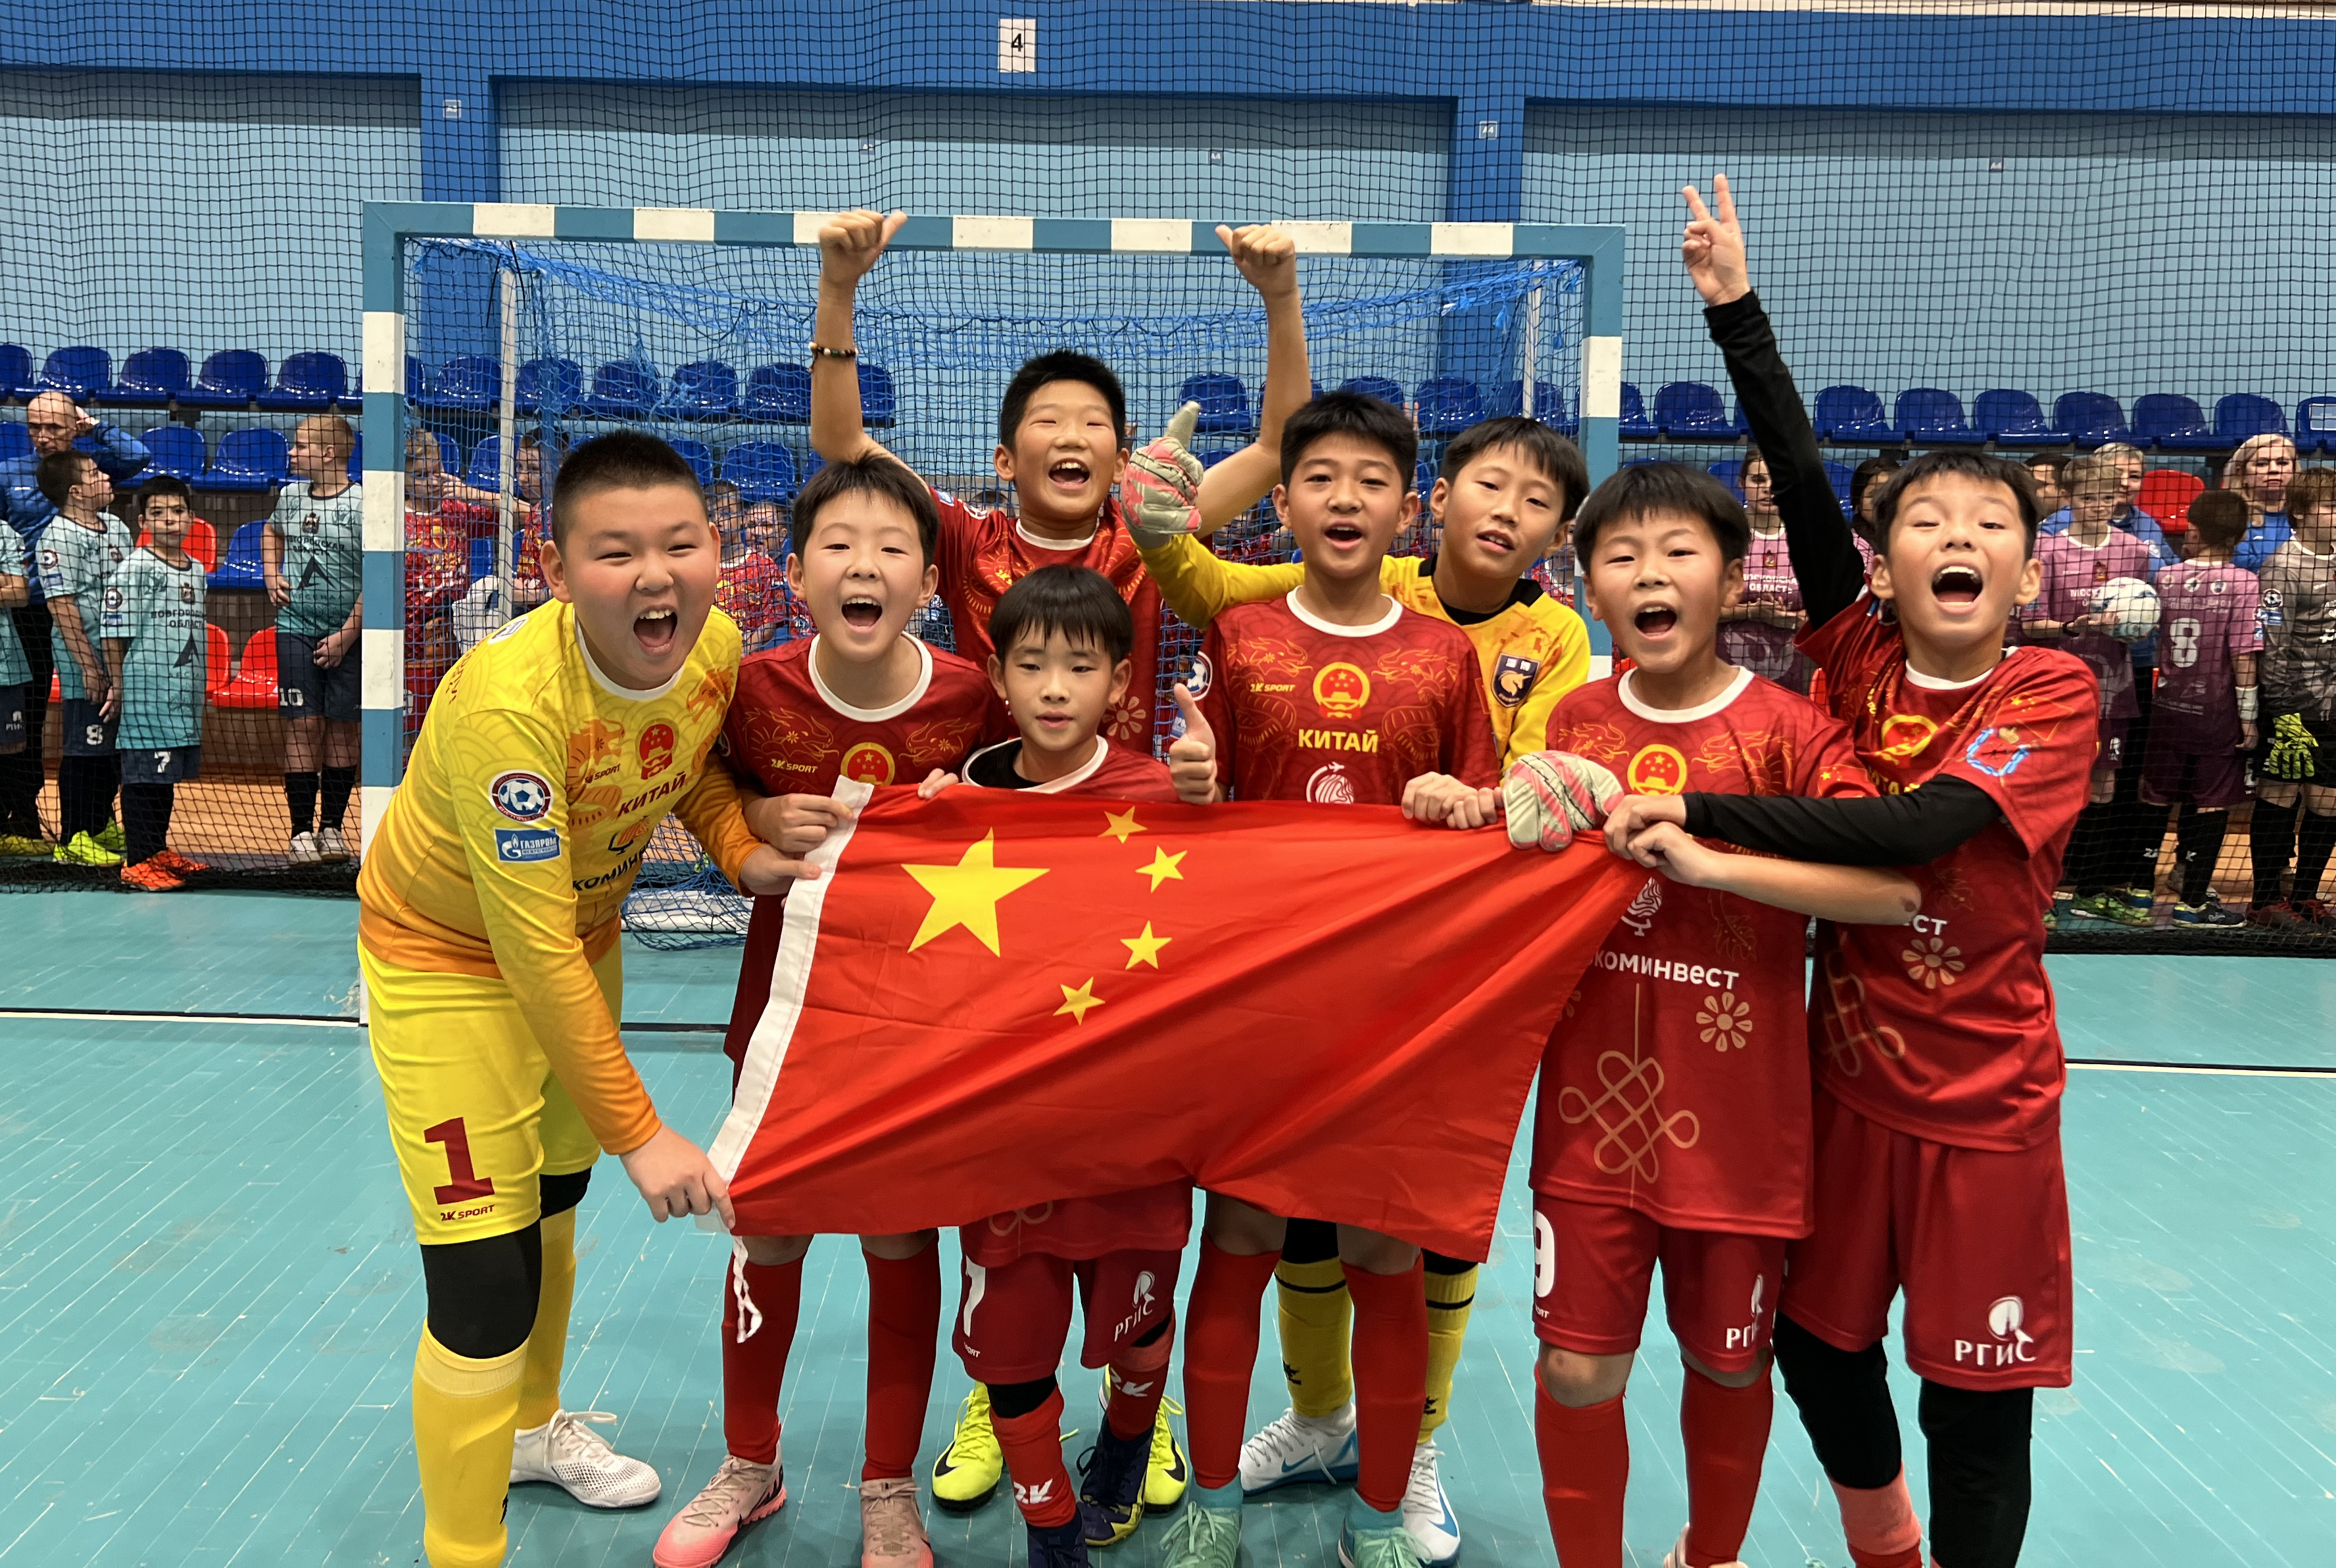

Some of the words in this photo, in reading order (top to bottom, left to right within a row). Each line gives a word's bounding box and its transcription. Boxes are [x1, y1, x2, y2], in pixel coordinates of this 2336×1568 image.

[1011, 33, 1023, 52] 4
[2170, 617, 2201, 668] 8
[279, 688, 304, 706] 10
[86, 724, 103, 745] 8
[1298, 729, 1379, 753] КИТАЙ
[155, 751, 171, 773] 7
[594, 763, 620, 780] SPORT
[786, 763, 818, 773] SPORT
[616, 771, 686, 818] КИТАЙ
[520, 837, 556, 849] ГАЗПРОМ
[424, 1117, 495, 1205] 1
[458, 1204, 495, 1219] SPORT
[1955, 1339, 2037, 1367] РГИС
